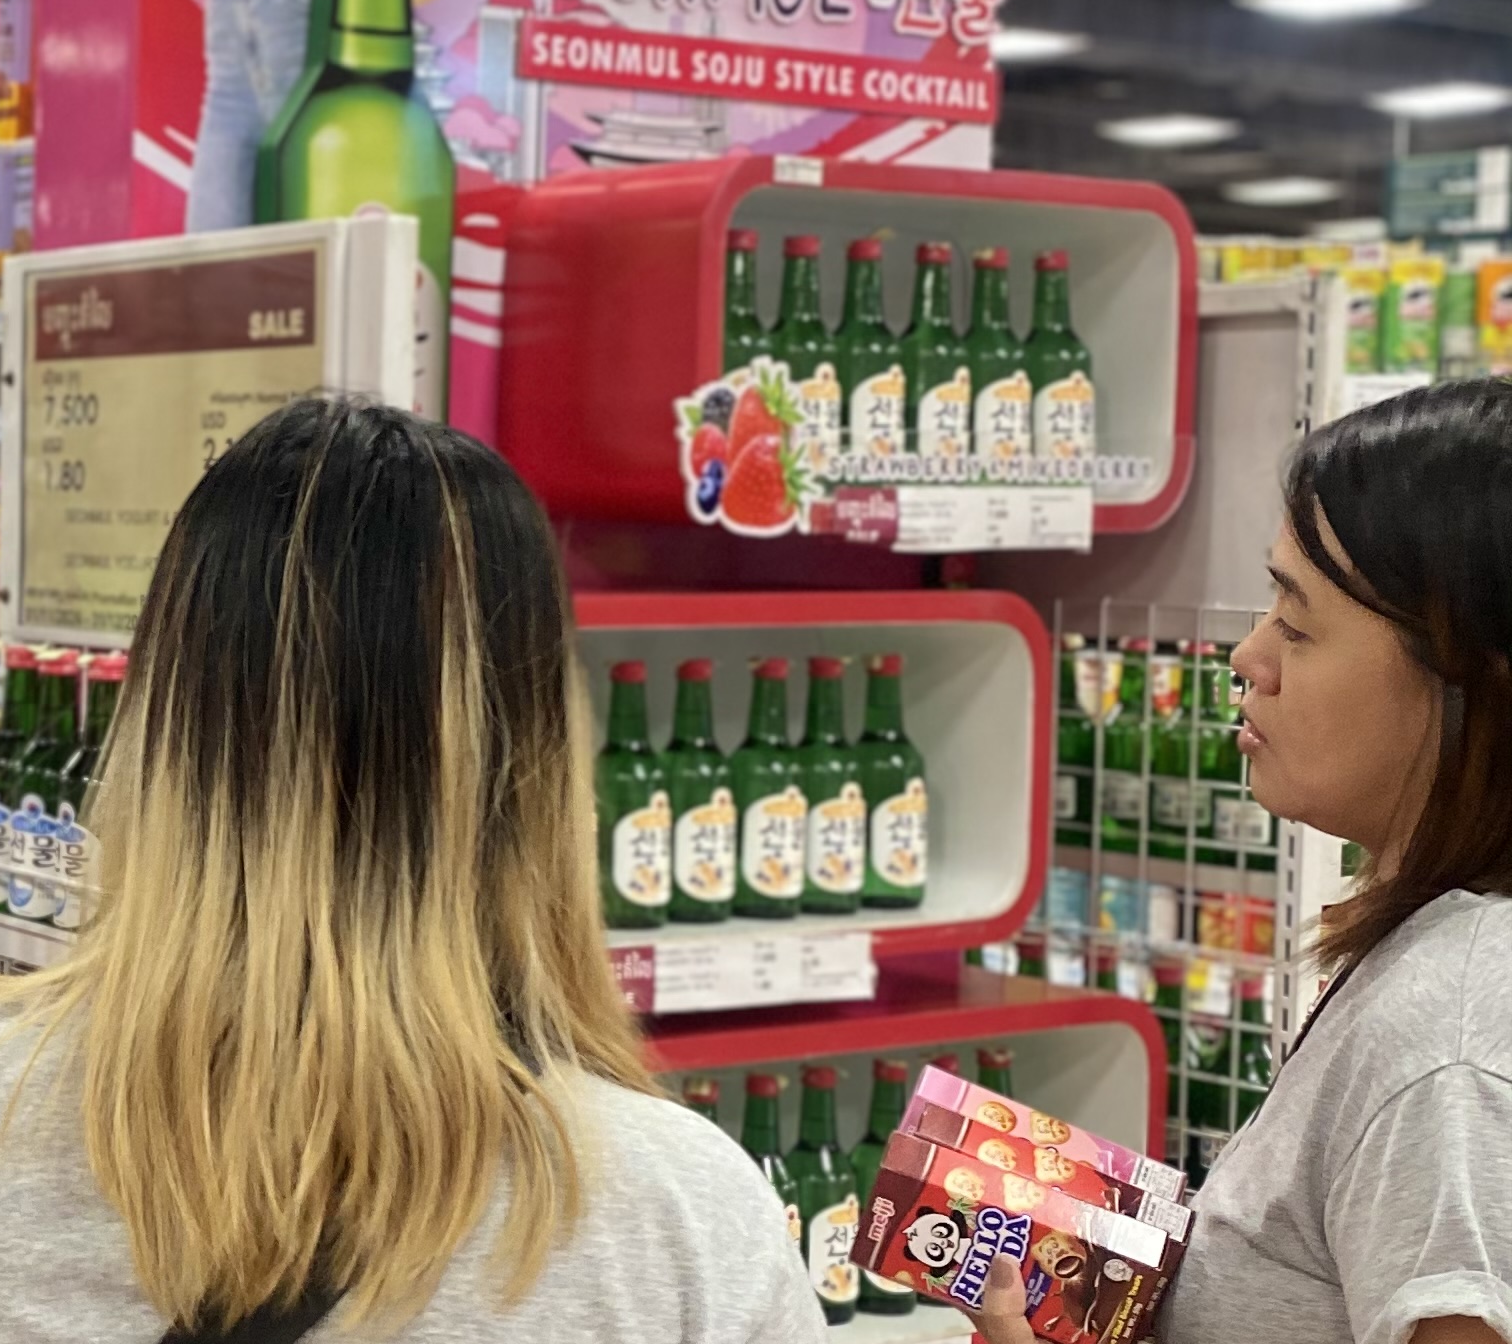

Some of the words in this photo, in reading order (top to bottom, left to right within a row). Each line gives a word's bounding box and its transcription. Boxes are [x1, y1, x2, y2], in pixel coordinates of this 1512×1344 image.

[533, 33, 682, 80] SEONMUL
[691, 52, 765, 87] SOJU
[776, 58, 854, 96] STYLE
[863, 69, 989, 110] COCKTAIL
[248, 309, 305, 340] SALE
[44, 394, 98, 428] 7,500
[868, 1196, 896, 1242] meiji
[951, 1207, 1005, 1306] HELLO
